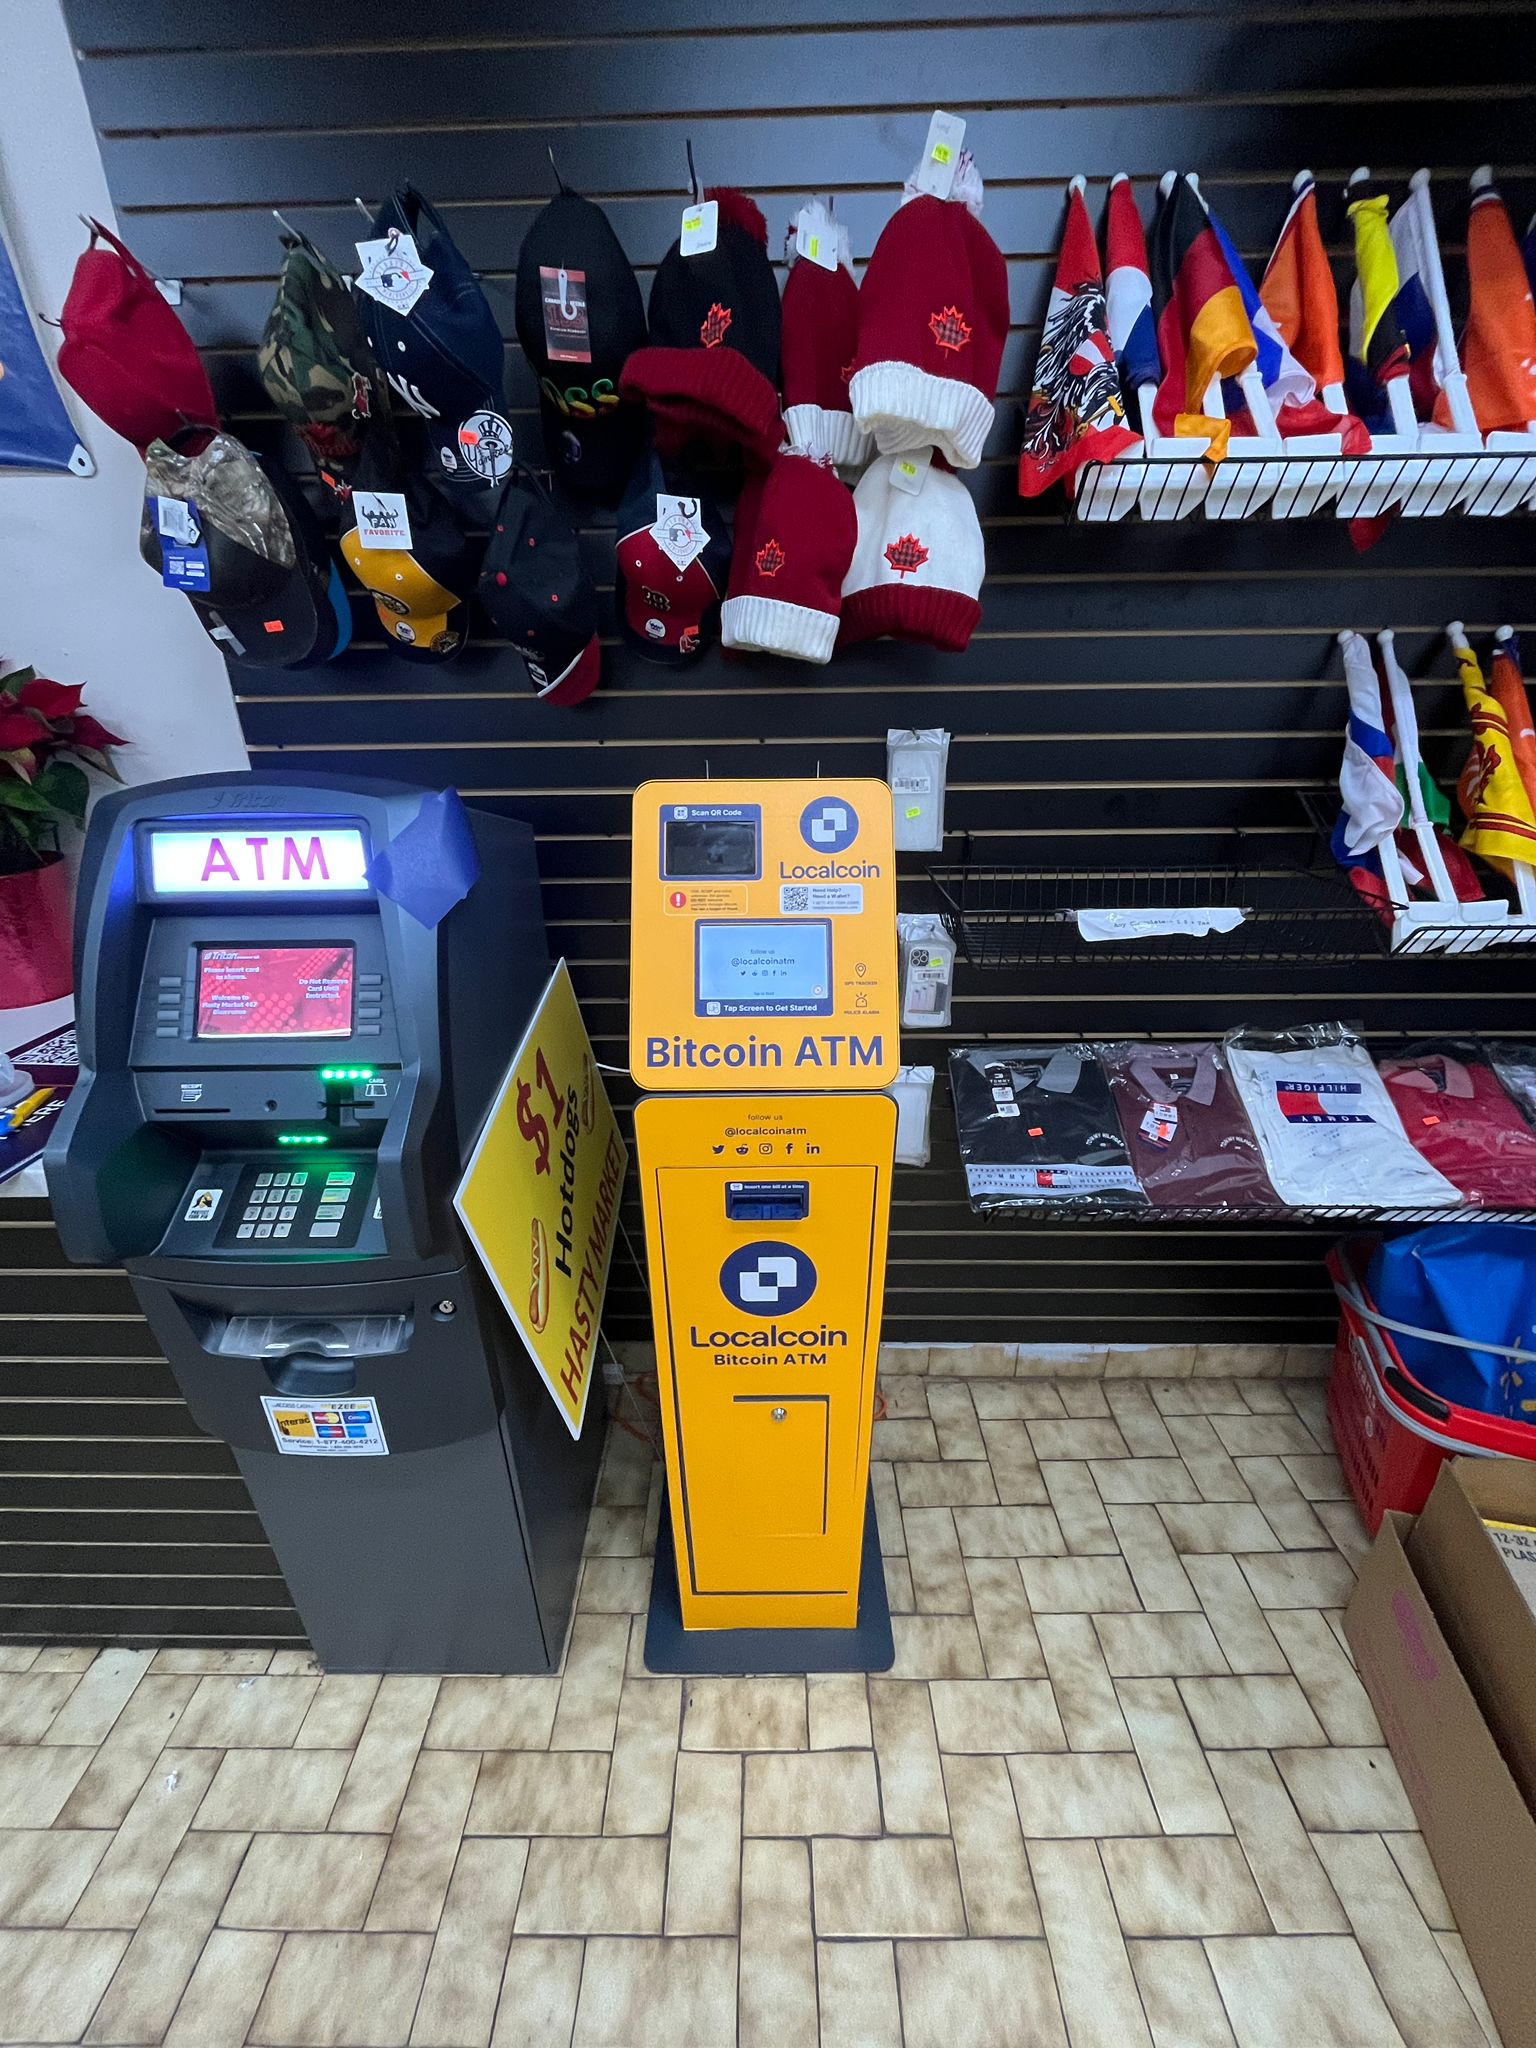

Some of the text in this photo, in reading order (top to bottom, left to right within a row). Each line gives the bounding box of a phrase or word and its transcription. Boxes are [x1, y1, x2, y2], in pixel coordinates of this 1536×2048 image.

[370, 517, 396, 528] FAN
[711, 809, 721, 817] QR
[201, 836, 330, 881] ATM
[780, 860, 880, 879] Localcoin
[213, 951, 238, 960] Triton
[731, 957, 795, 967] @localcoinatm
[739, 1004, 764, 1012] Screen
[775, 1004, 790, 1012] Get
[792, 1004, 817, 1012] Started
[646, 1035, 883, 1067] Bitcoin ATM
[1288, 1083, 1347, 1092] HILFIGER
[516, 1047, 565, 1176] $1
[747, 1113, 766, 1121] follow
[1301, 1114, 1363, 1122] TOMMY
[724, 1127, 807, 1138] @localcoinatm
[555, 1083, 579, 1279] Hotdogs
[559, 1128, 622, 1405] HASTY MARKET
[690, 1324, 847, 1347] Localcoin
[714, 1353, 827, 1366] Bitcoin ATM
[277, 1416, 311, 1426] Interac
[282, 1437, 314, 1445] Service:
[1493, 1533, 1531, 1547] 12-32
